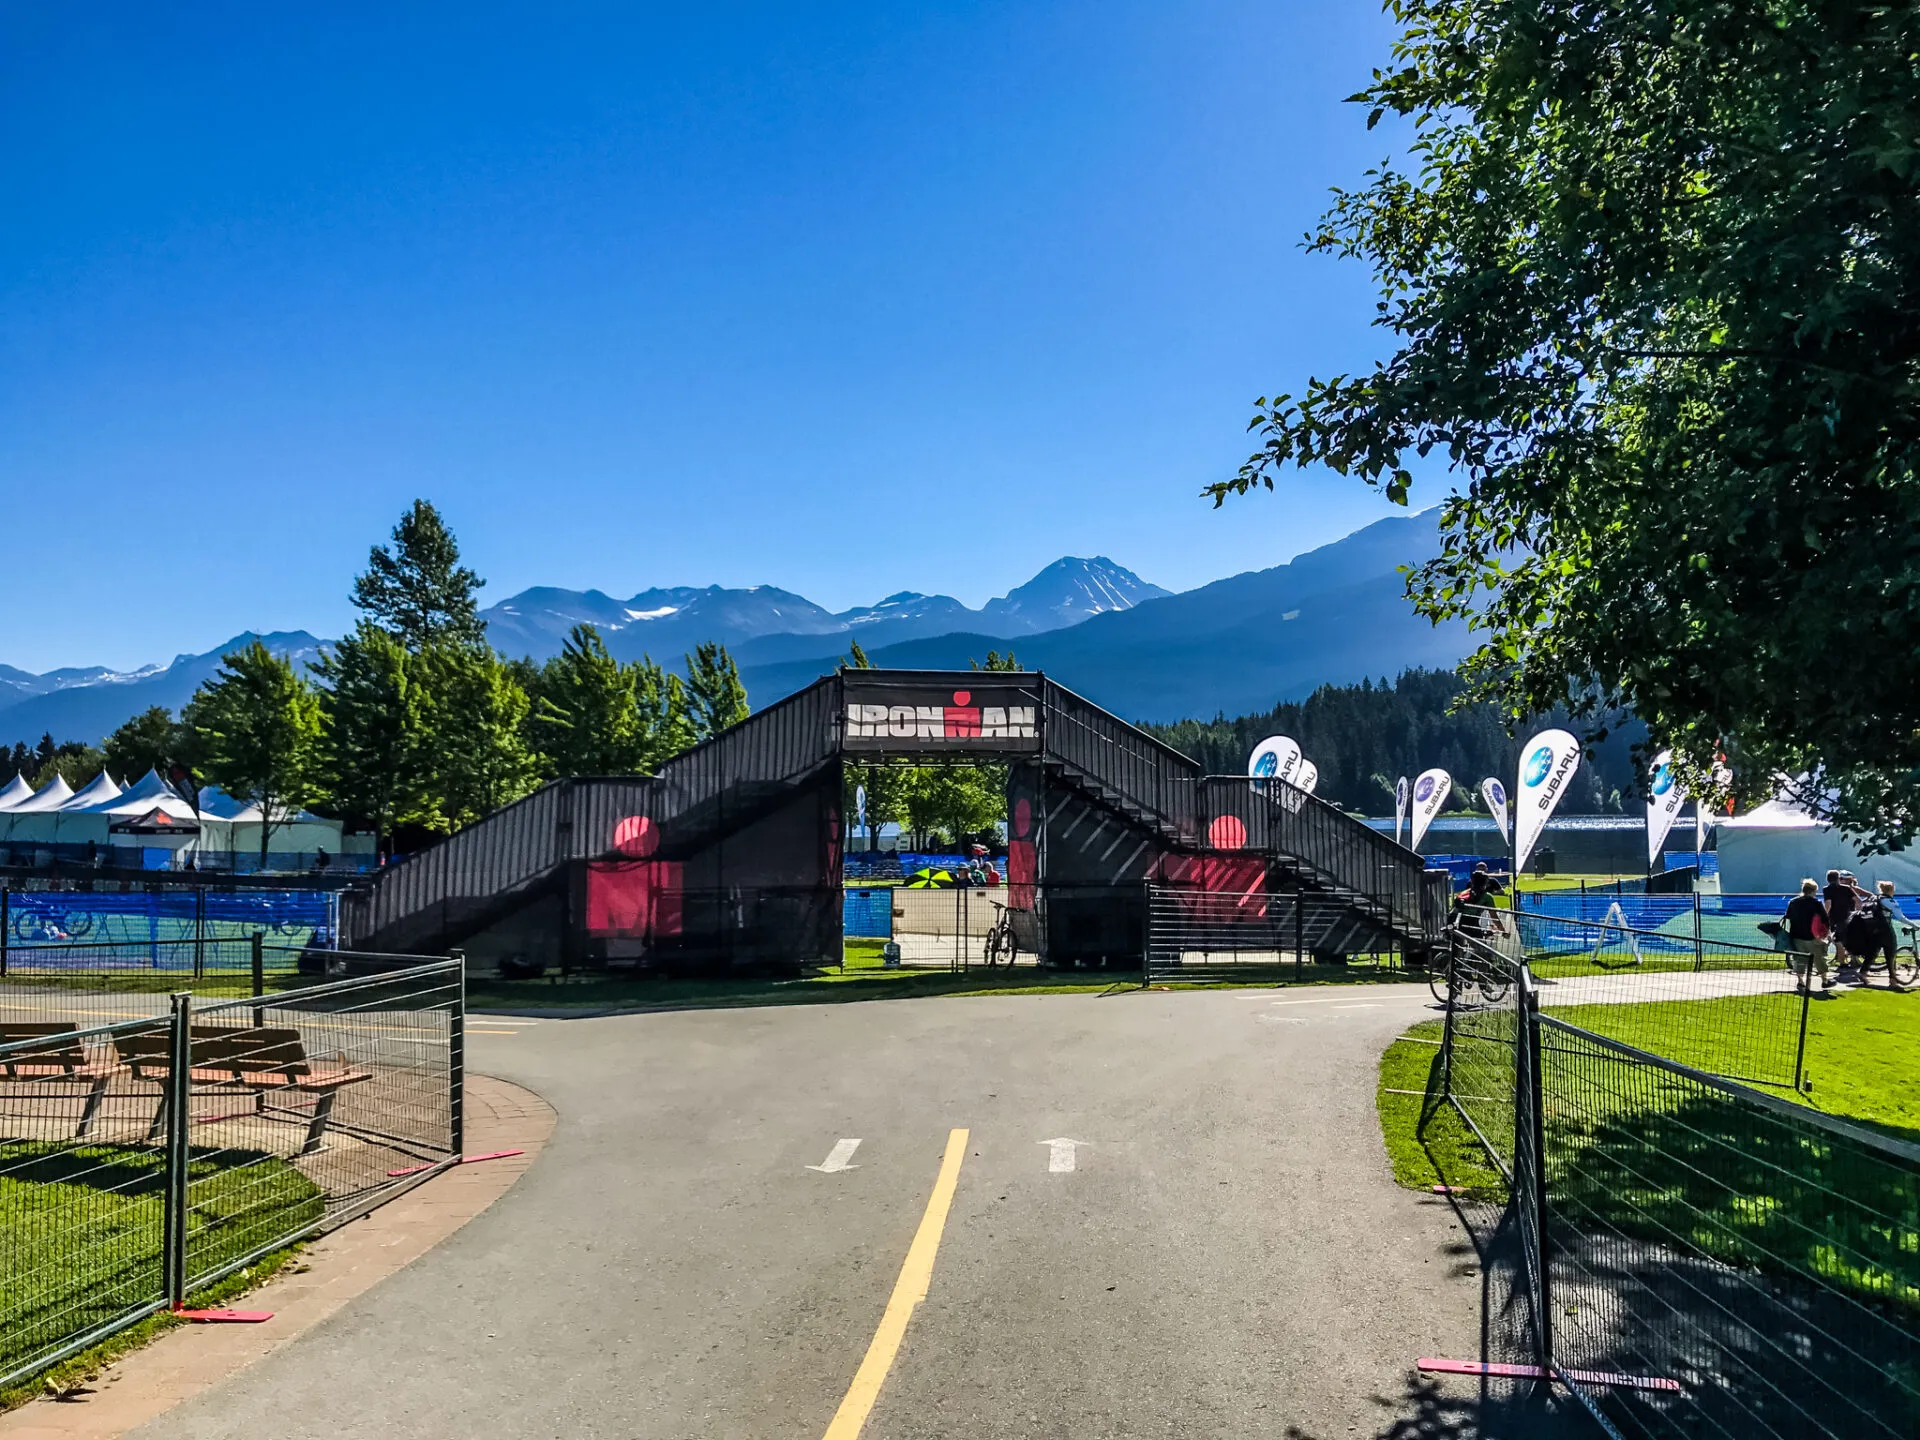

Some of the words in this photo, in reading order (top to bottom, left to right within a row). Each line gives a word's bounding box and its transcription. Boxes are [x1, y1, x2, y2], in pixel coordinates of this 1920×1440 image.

[847, 691, 1035, 738] IRONMAN
[1425, 776, 1450, 815] SUBARU
[1538, 746, 1580, 810] SUBARU
